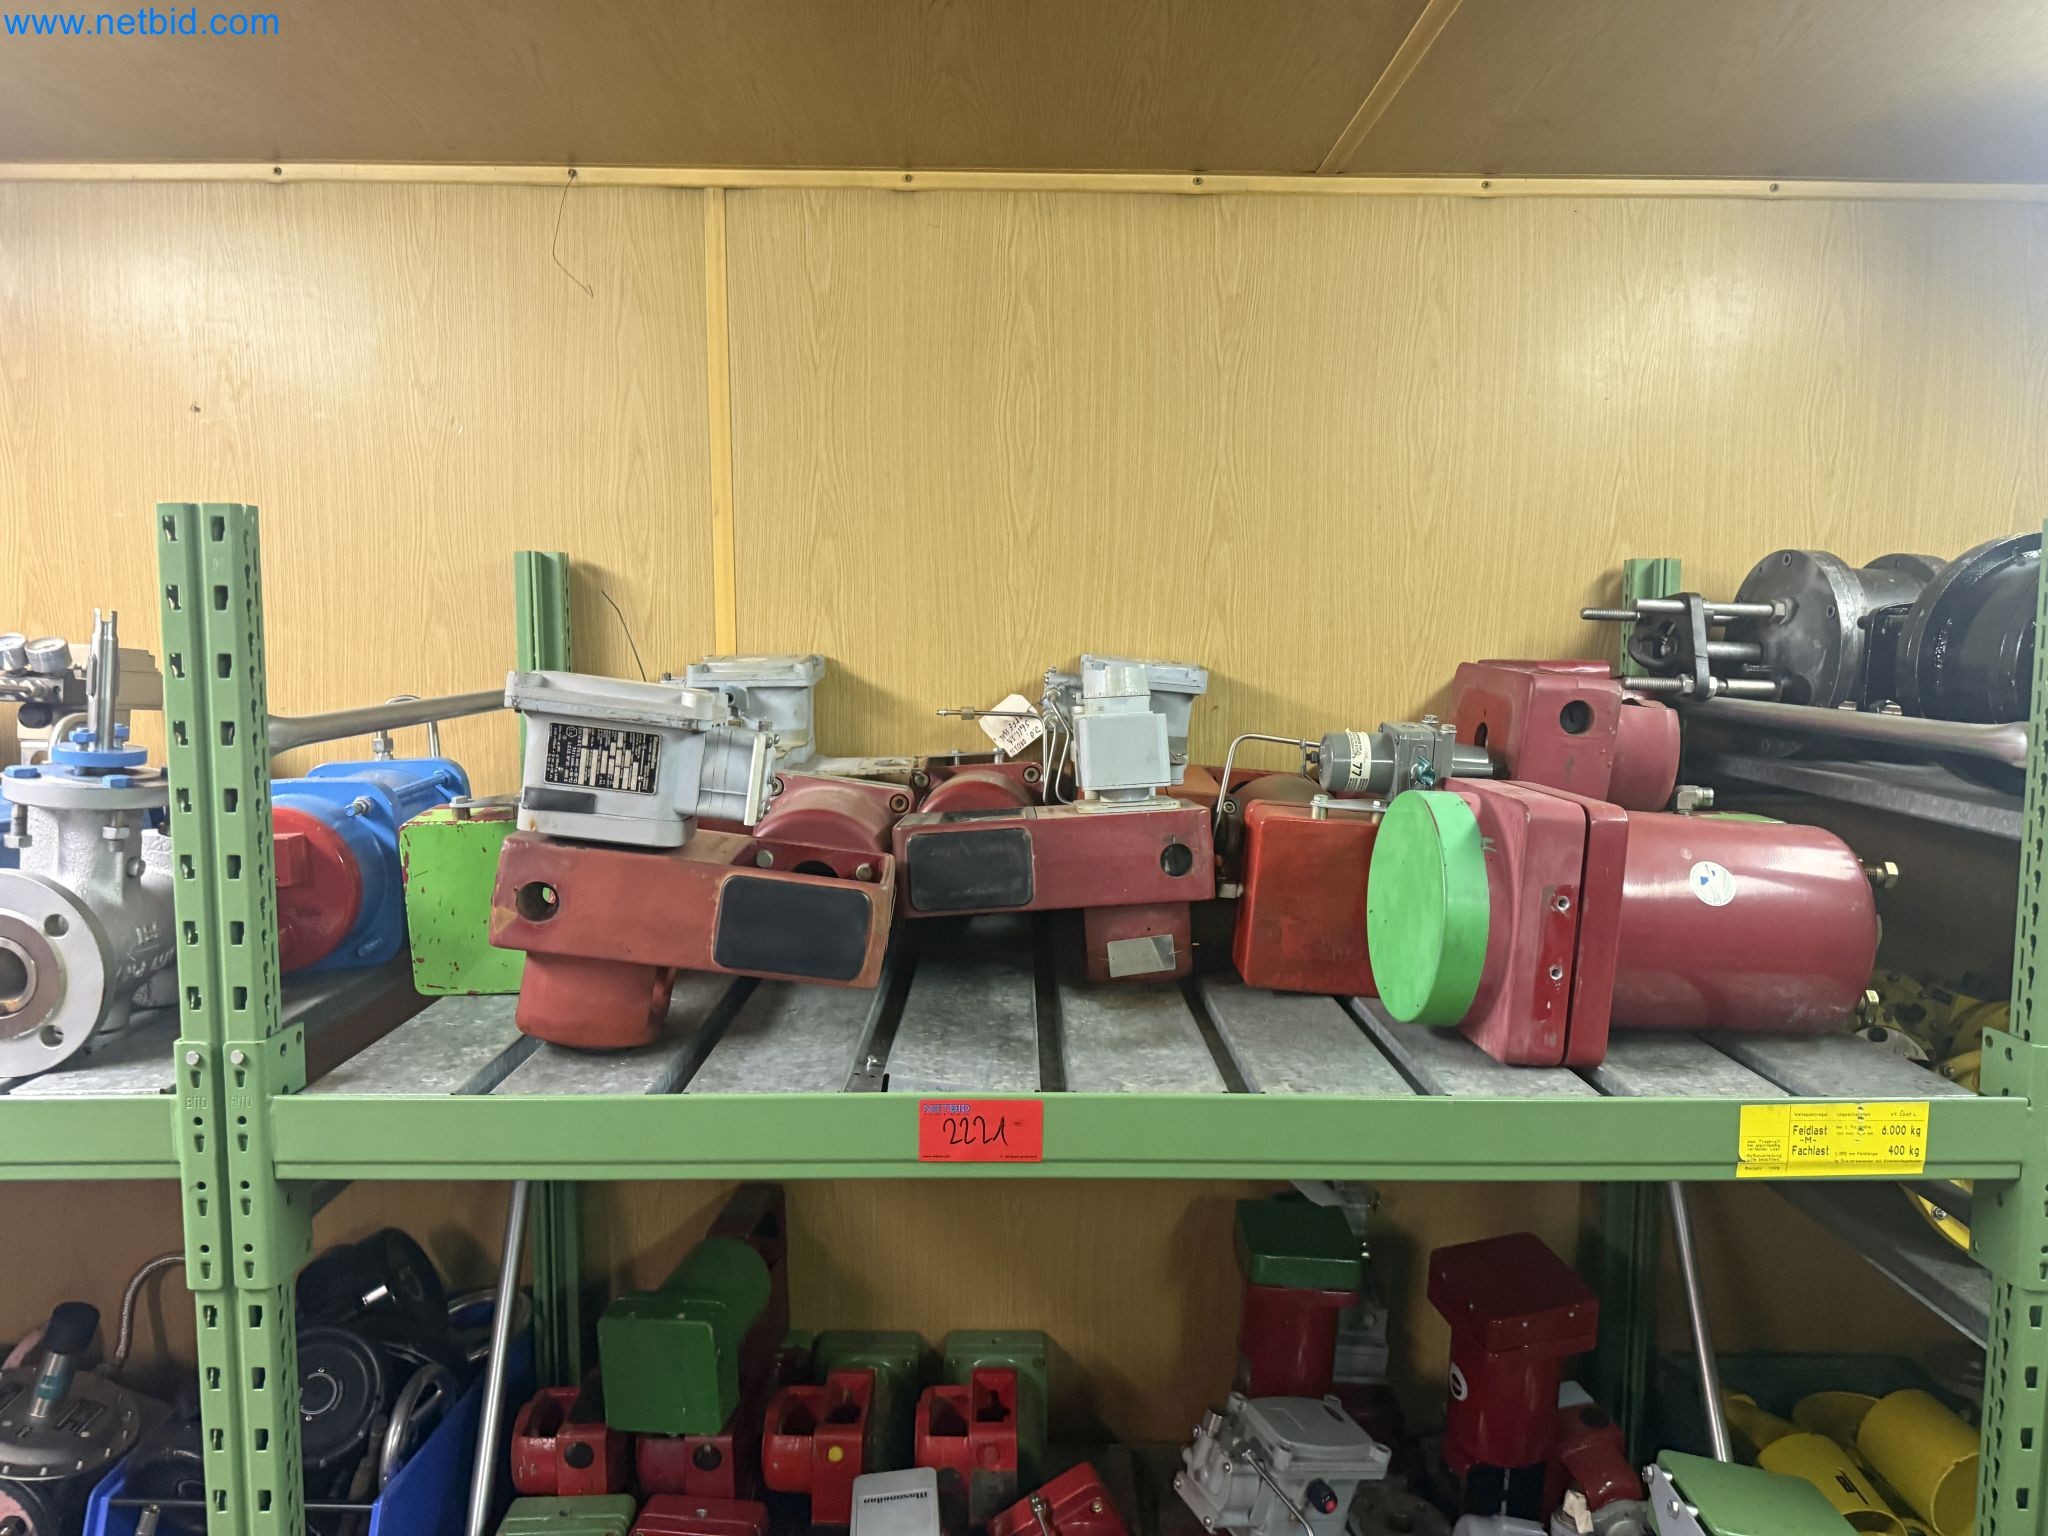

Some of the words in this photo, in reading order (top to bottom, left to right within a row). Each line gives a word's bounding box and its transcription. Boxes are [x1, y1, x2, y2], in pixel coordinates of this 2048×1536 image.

[943, 1116, 1009, 1146] 2221
[1792, 1125, 1828, 1136] Feldlast
[1881, 1124, 1907, 1136] 6.000
[1910, 1124, 1921, 1137] kg
[1791, 1145, 1829, 1156] Fachlast
[1888, 1144, 1905, 1156] 400
[1909, 1144, 1920, 1157] kg
